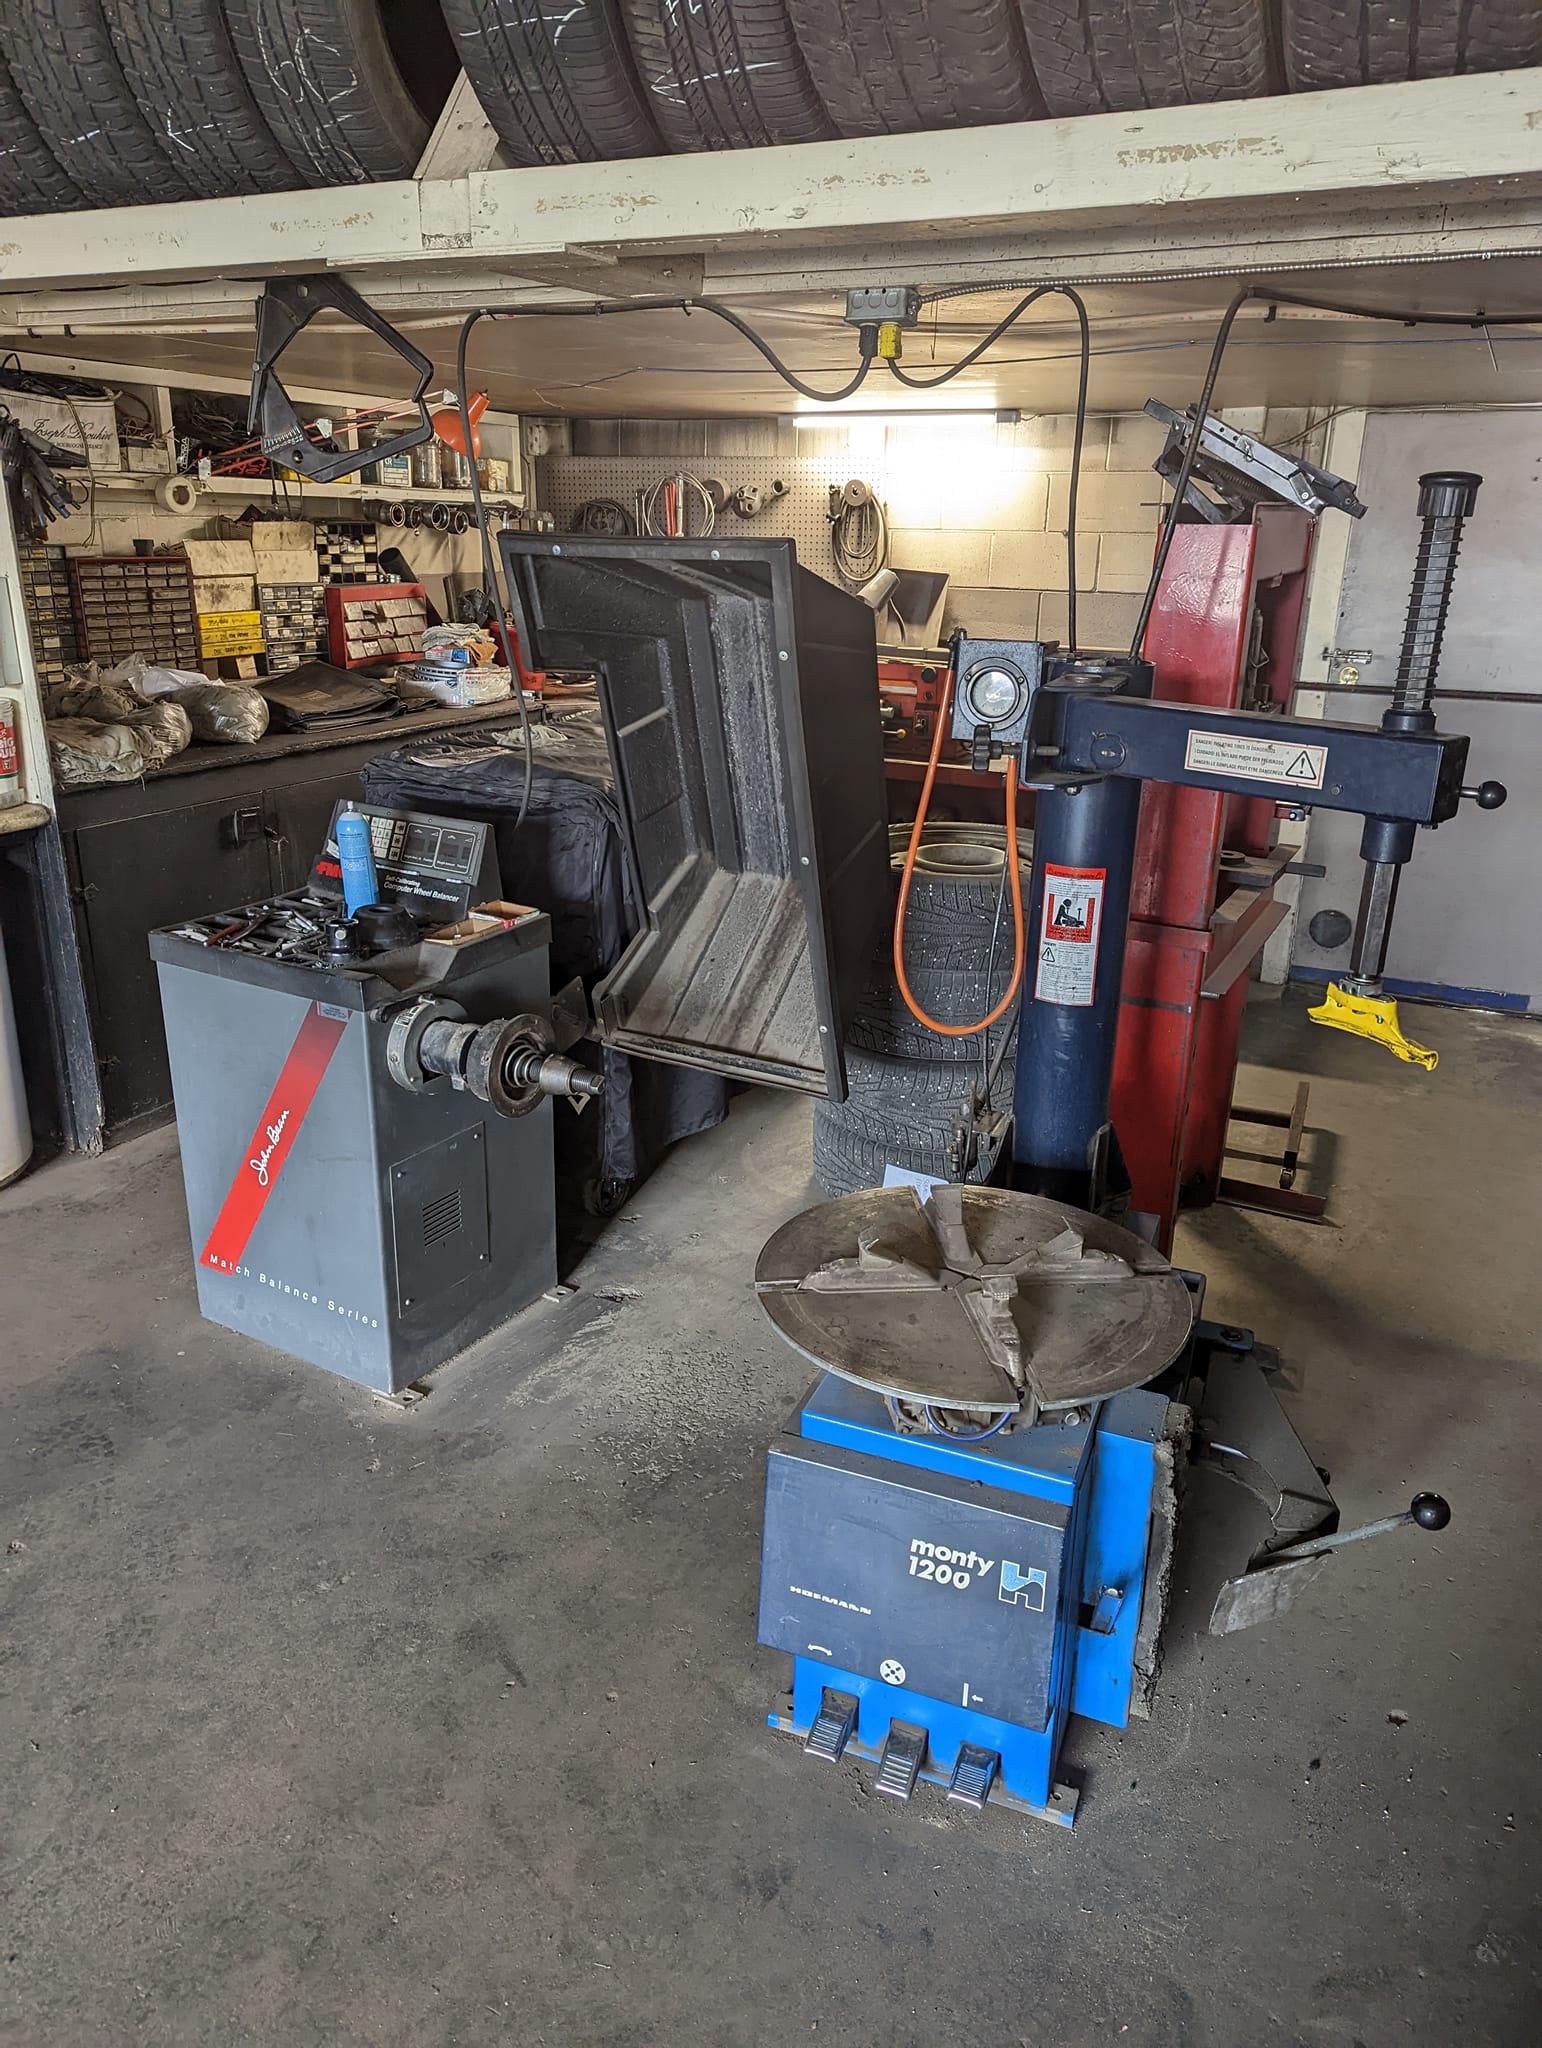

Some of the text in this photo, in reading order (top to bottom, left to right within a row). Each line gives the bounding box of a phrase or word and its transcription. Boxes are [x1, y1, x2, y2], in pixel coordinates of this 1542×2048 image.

[33, 418, 70, 440] Joseph
[384, 881, 460, 903] Computer Wheel Balancer
[250, 1110, 290, 1186] John Bean
[209, 1254, 378, 1328] Match Balance Series
[909, 1555, 970, 1590] 1200
[910, 1538, 995, 1577] monty
